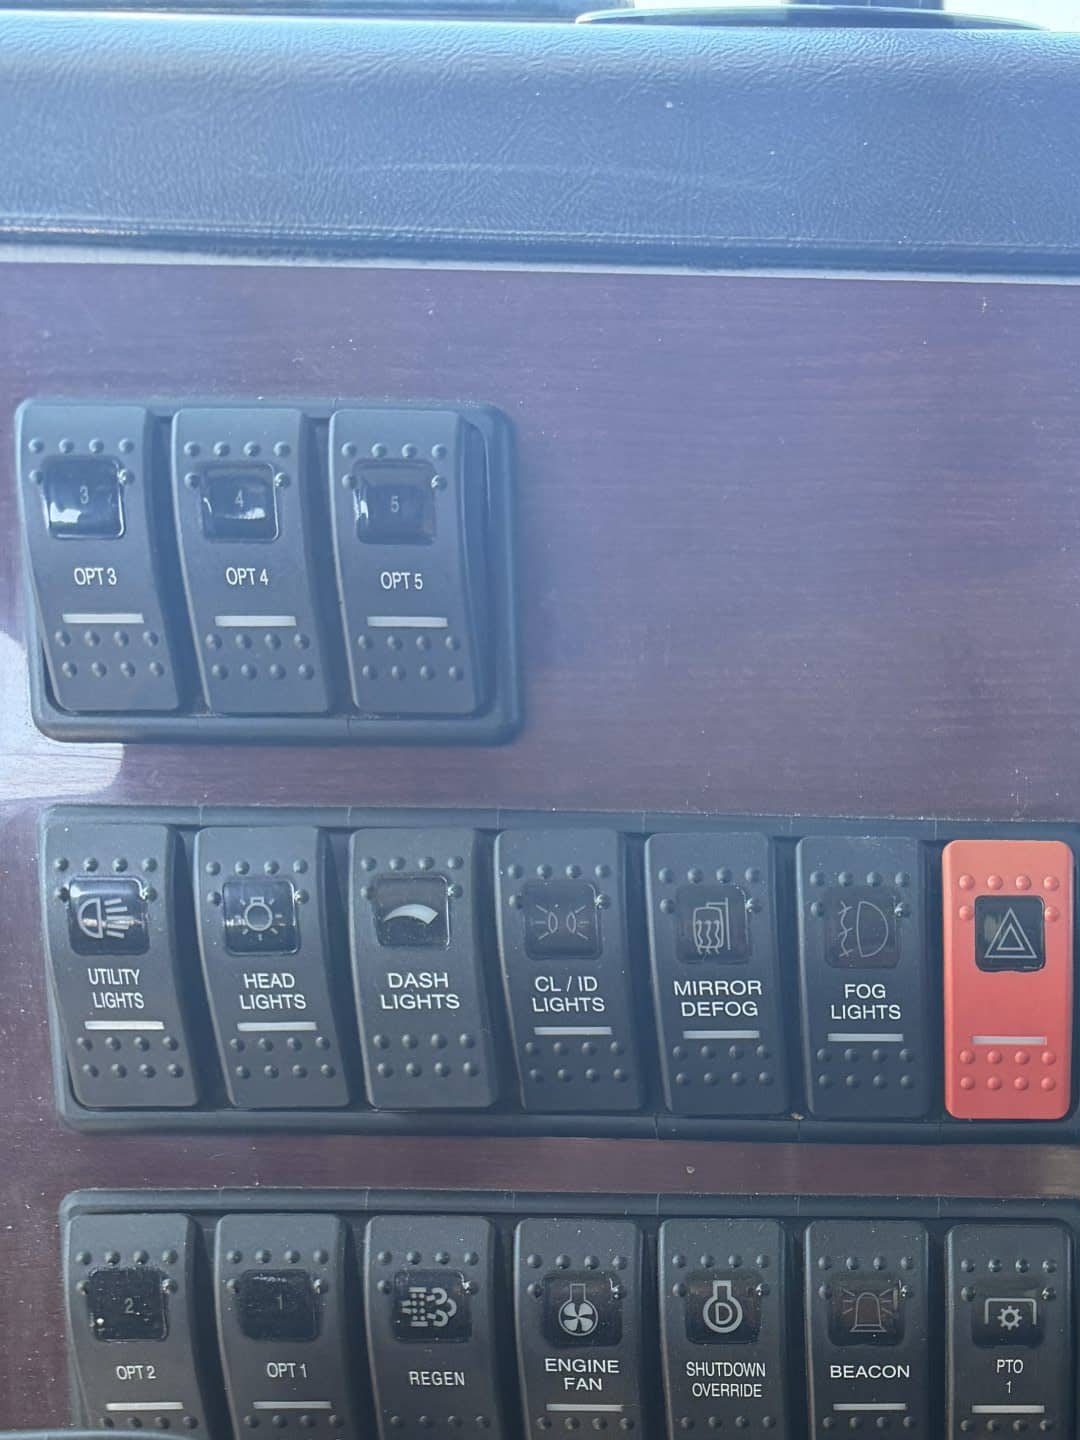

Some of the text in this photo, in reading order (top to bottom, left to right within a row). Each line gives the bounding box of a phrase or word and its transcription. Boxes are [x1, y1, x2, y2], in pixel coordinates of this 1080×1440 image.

[74, 568, 117, 585] OPT 3
[226, 568, 268, 585] OPT 4
[381, 572, 423, 590] OPT 5
[88, 968, 140, 985] UTILITY
[244, 973, 295, 988] HEAD
[388, 972, 448, 988] DASH
[535, 976, 560, 993] CL
[578, 976, 598, 993] ID
[674, 980, 763, 996] MIRROR
[844, 984, 886, 999] FOG
[93, 992, 144, 1009] LIGHTS
[240, 994, 306, 1009] LIGHTS
[381, 994, 460, 1009] LIGHTS
[532, 997, 605, 1013] LIGHTS
[681, 1001, 758, 1017] DEFOG
[830, 1004, 901, 1020] LIGHTS
[117, 1365, 156, 1381] OPT 2
[267, 1363, 307, 1378] OPT 1
[545, 1359, 619, 1374] ENGINE
[686, 1361, 766, 1377] SHUTDOWN
[830, 1365, 910, 1378] BEACON
[996, 1359, 1024, 1374] PTO
[409, 1371, 465, 1386] REGEN
[564, 1377, 602, 1392] FAN
[692, 1381, 762, 1397] OVERRIDE
[1005, 1381, 1012, 1393] 1
